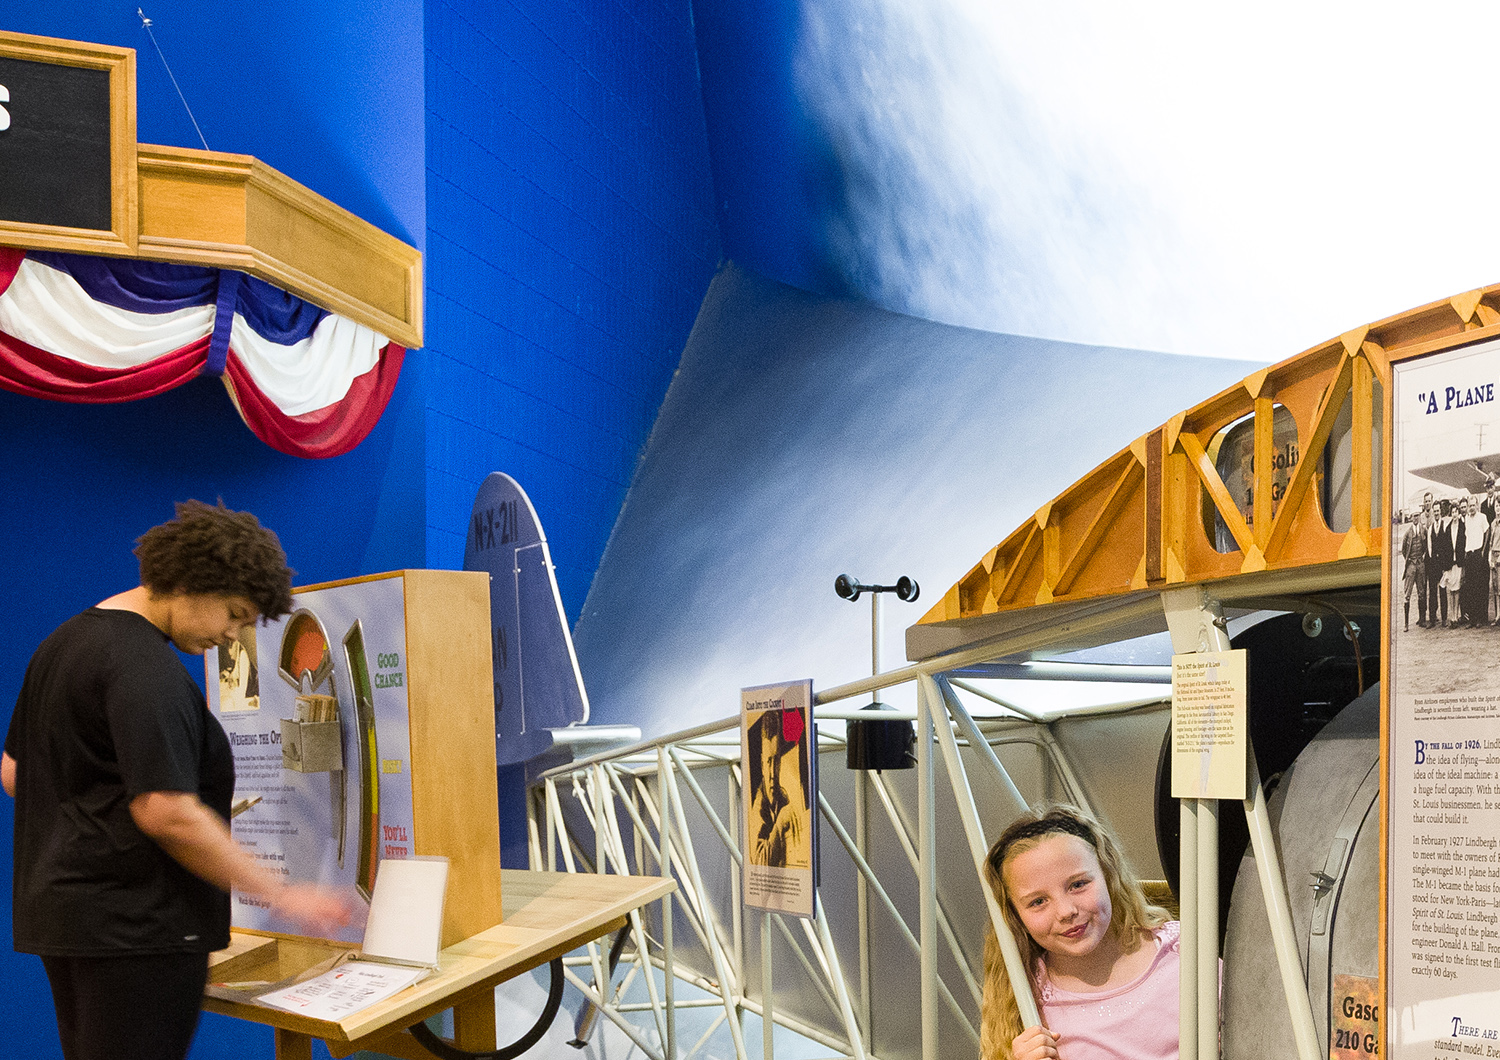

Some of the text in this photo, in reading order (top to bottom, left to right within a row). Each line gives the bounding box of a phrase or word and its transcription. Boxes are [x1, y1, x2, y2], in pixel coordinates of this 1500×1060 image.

[1445, 383, 1494, 411] PLANE
[378, 653, 399, 668] GOOD
[375, 673, 403, 688] CHANCE
[1451, 1016, 1480, 1037] THERE
[1482, 1029, 1498, 1039] ARE
[1336, 1029, 1359, 1050] 210
[1434, 1040, 1461, 1052] standard
[1464, 1044, 1484, 1056] model.
